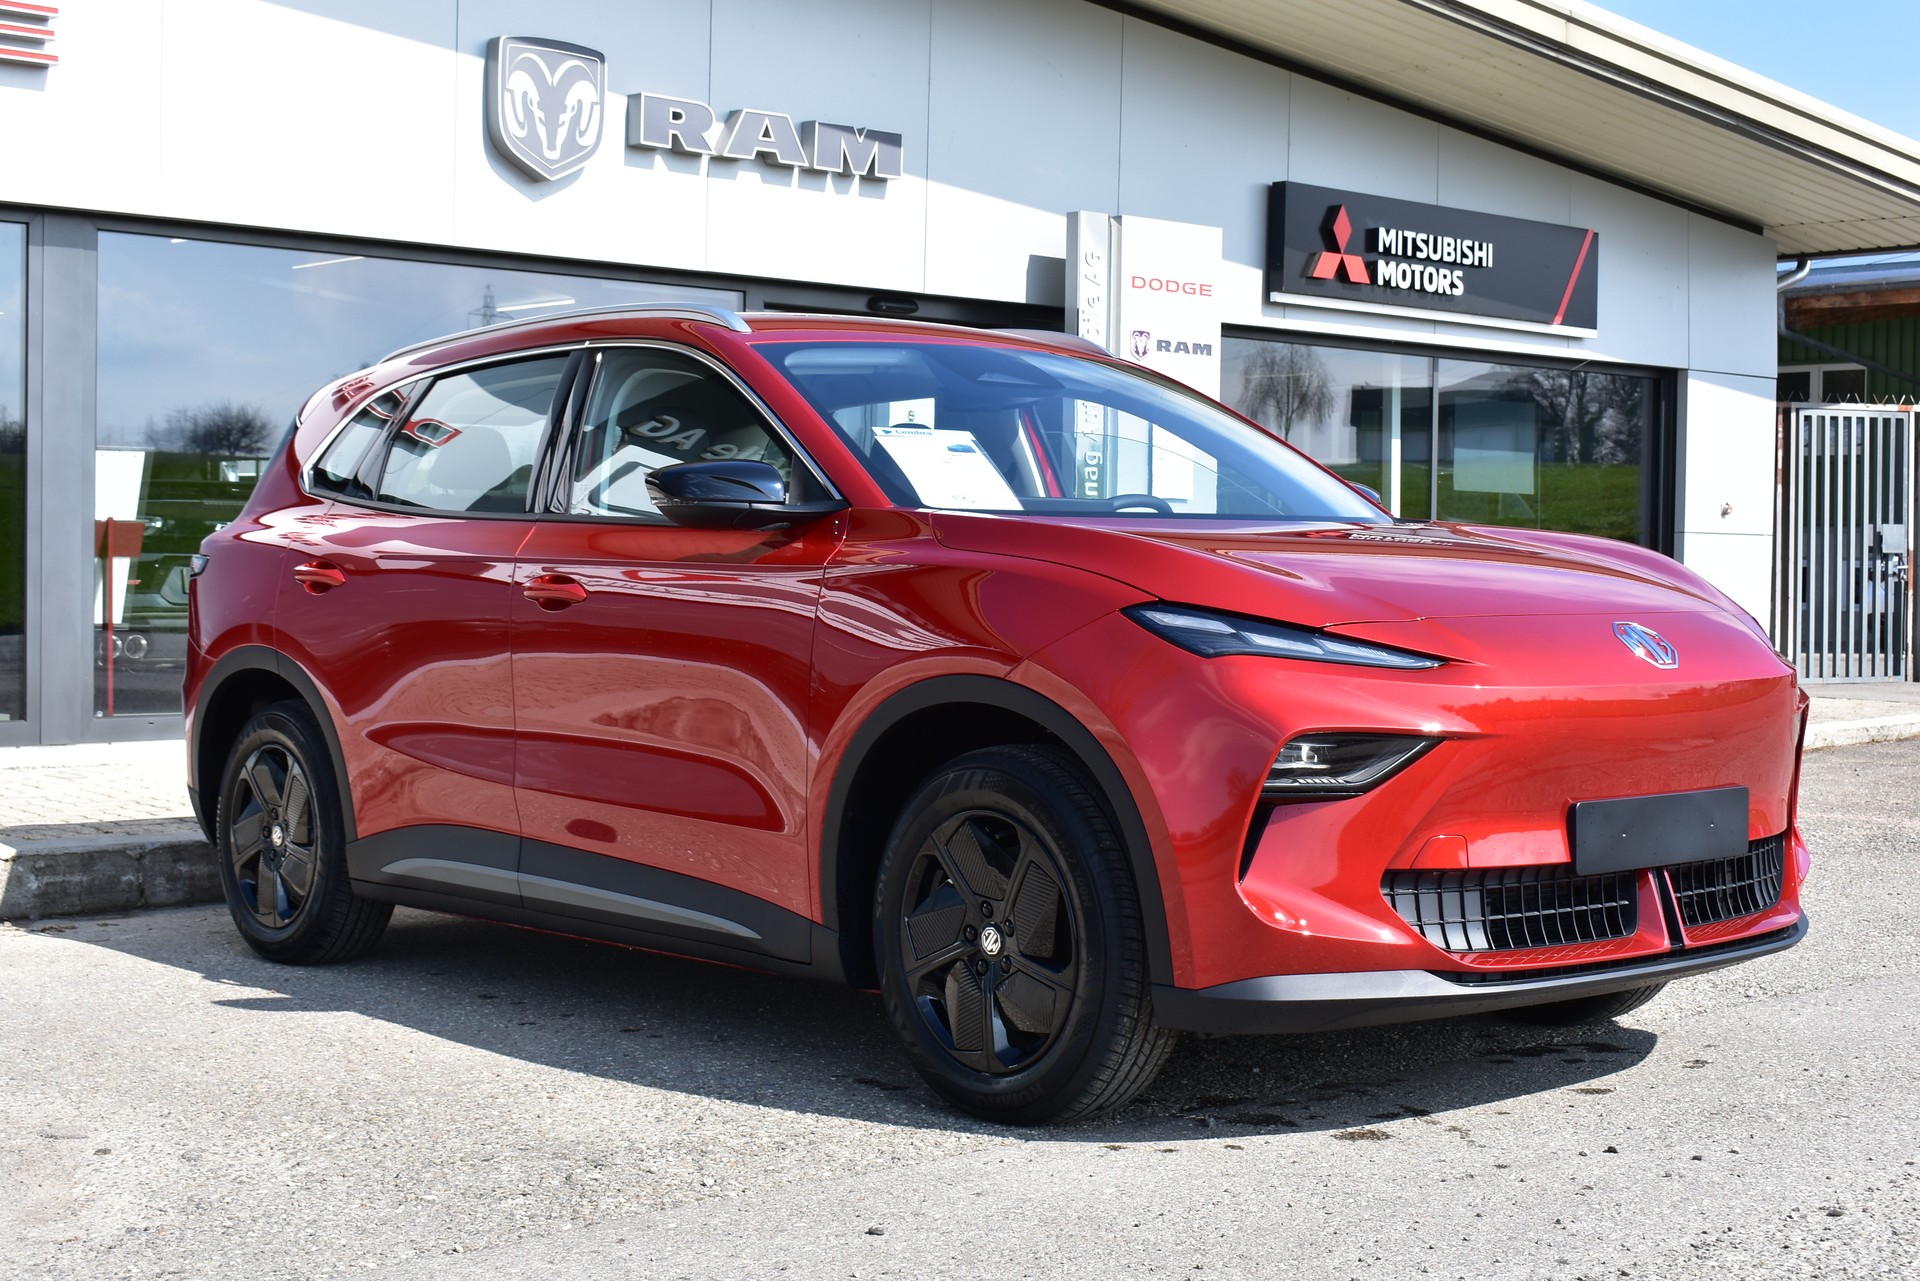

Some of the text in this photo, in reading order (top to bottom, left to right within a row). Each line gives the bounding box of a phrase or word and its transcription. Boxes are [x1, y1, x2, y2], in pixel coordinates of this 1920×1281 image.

[628, 92, 903, 180] RAM
[1377, 226, 1494, 268] MITSUBISHI
[1131, 275, 1213, 297] DODGE
[1376, 259, 1465, 296] MOTORS
[1156, 339, 1213, 357] RAM
